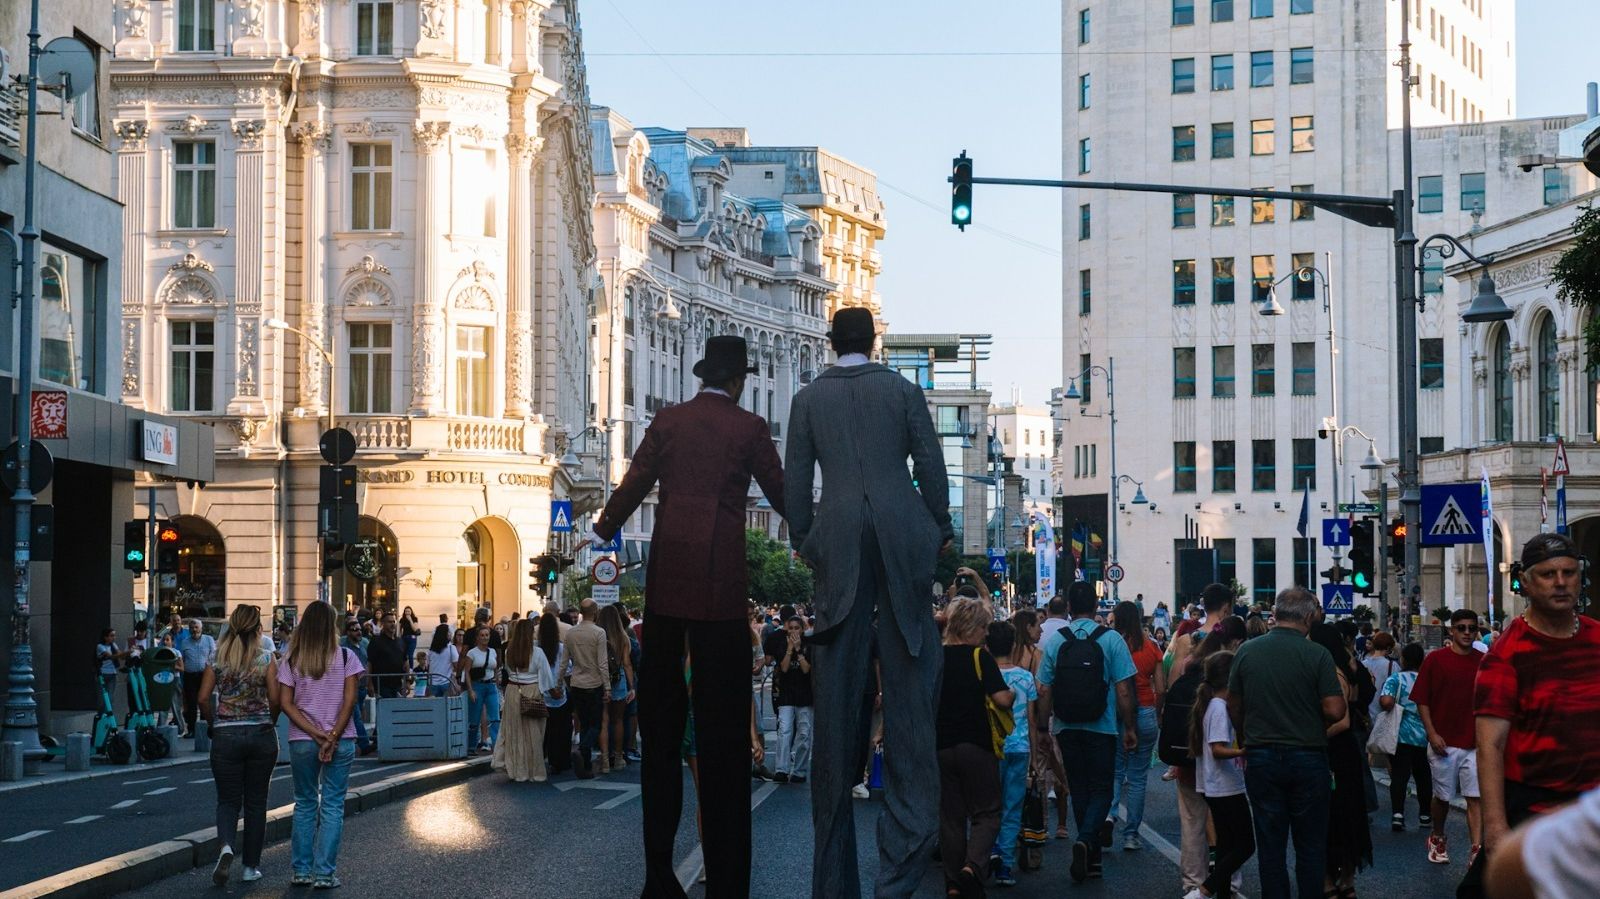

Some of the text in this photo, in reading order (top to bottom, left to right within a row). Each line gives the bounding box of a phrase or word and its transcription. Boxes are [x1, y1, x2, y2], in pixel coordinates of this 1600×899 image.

[145, 428, 162, 454] ING
[357, 469, 415, 484] RAND
[427, 470, 487, 484] HOTEL
[1110, 569, 1120, 579] 30
